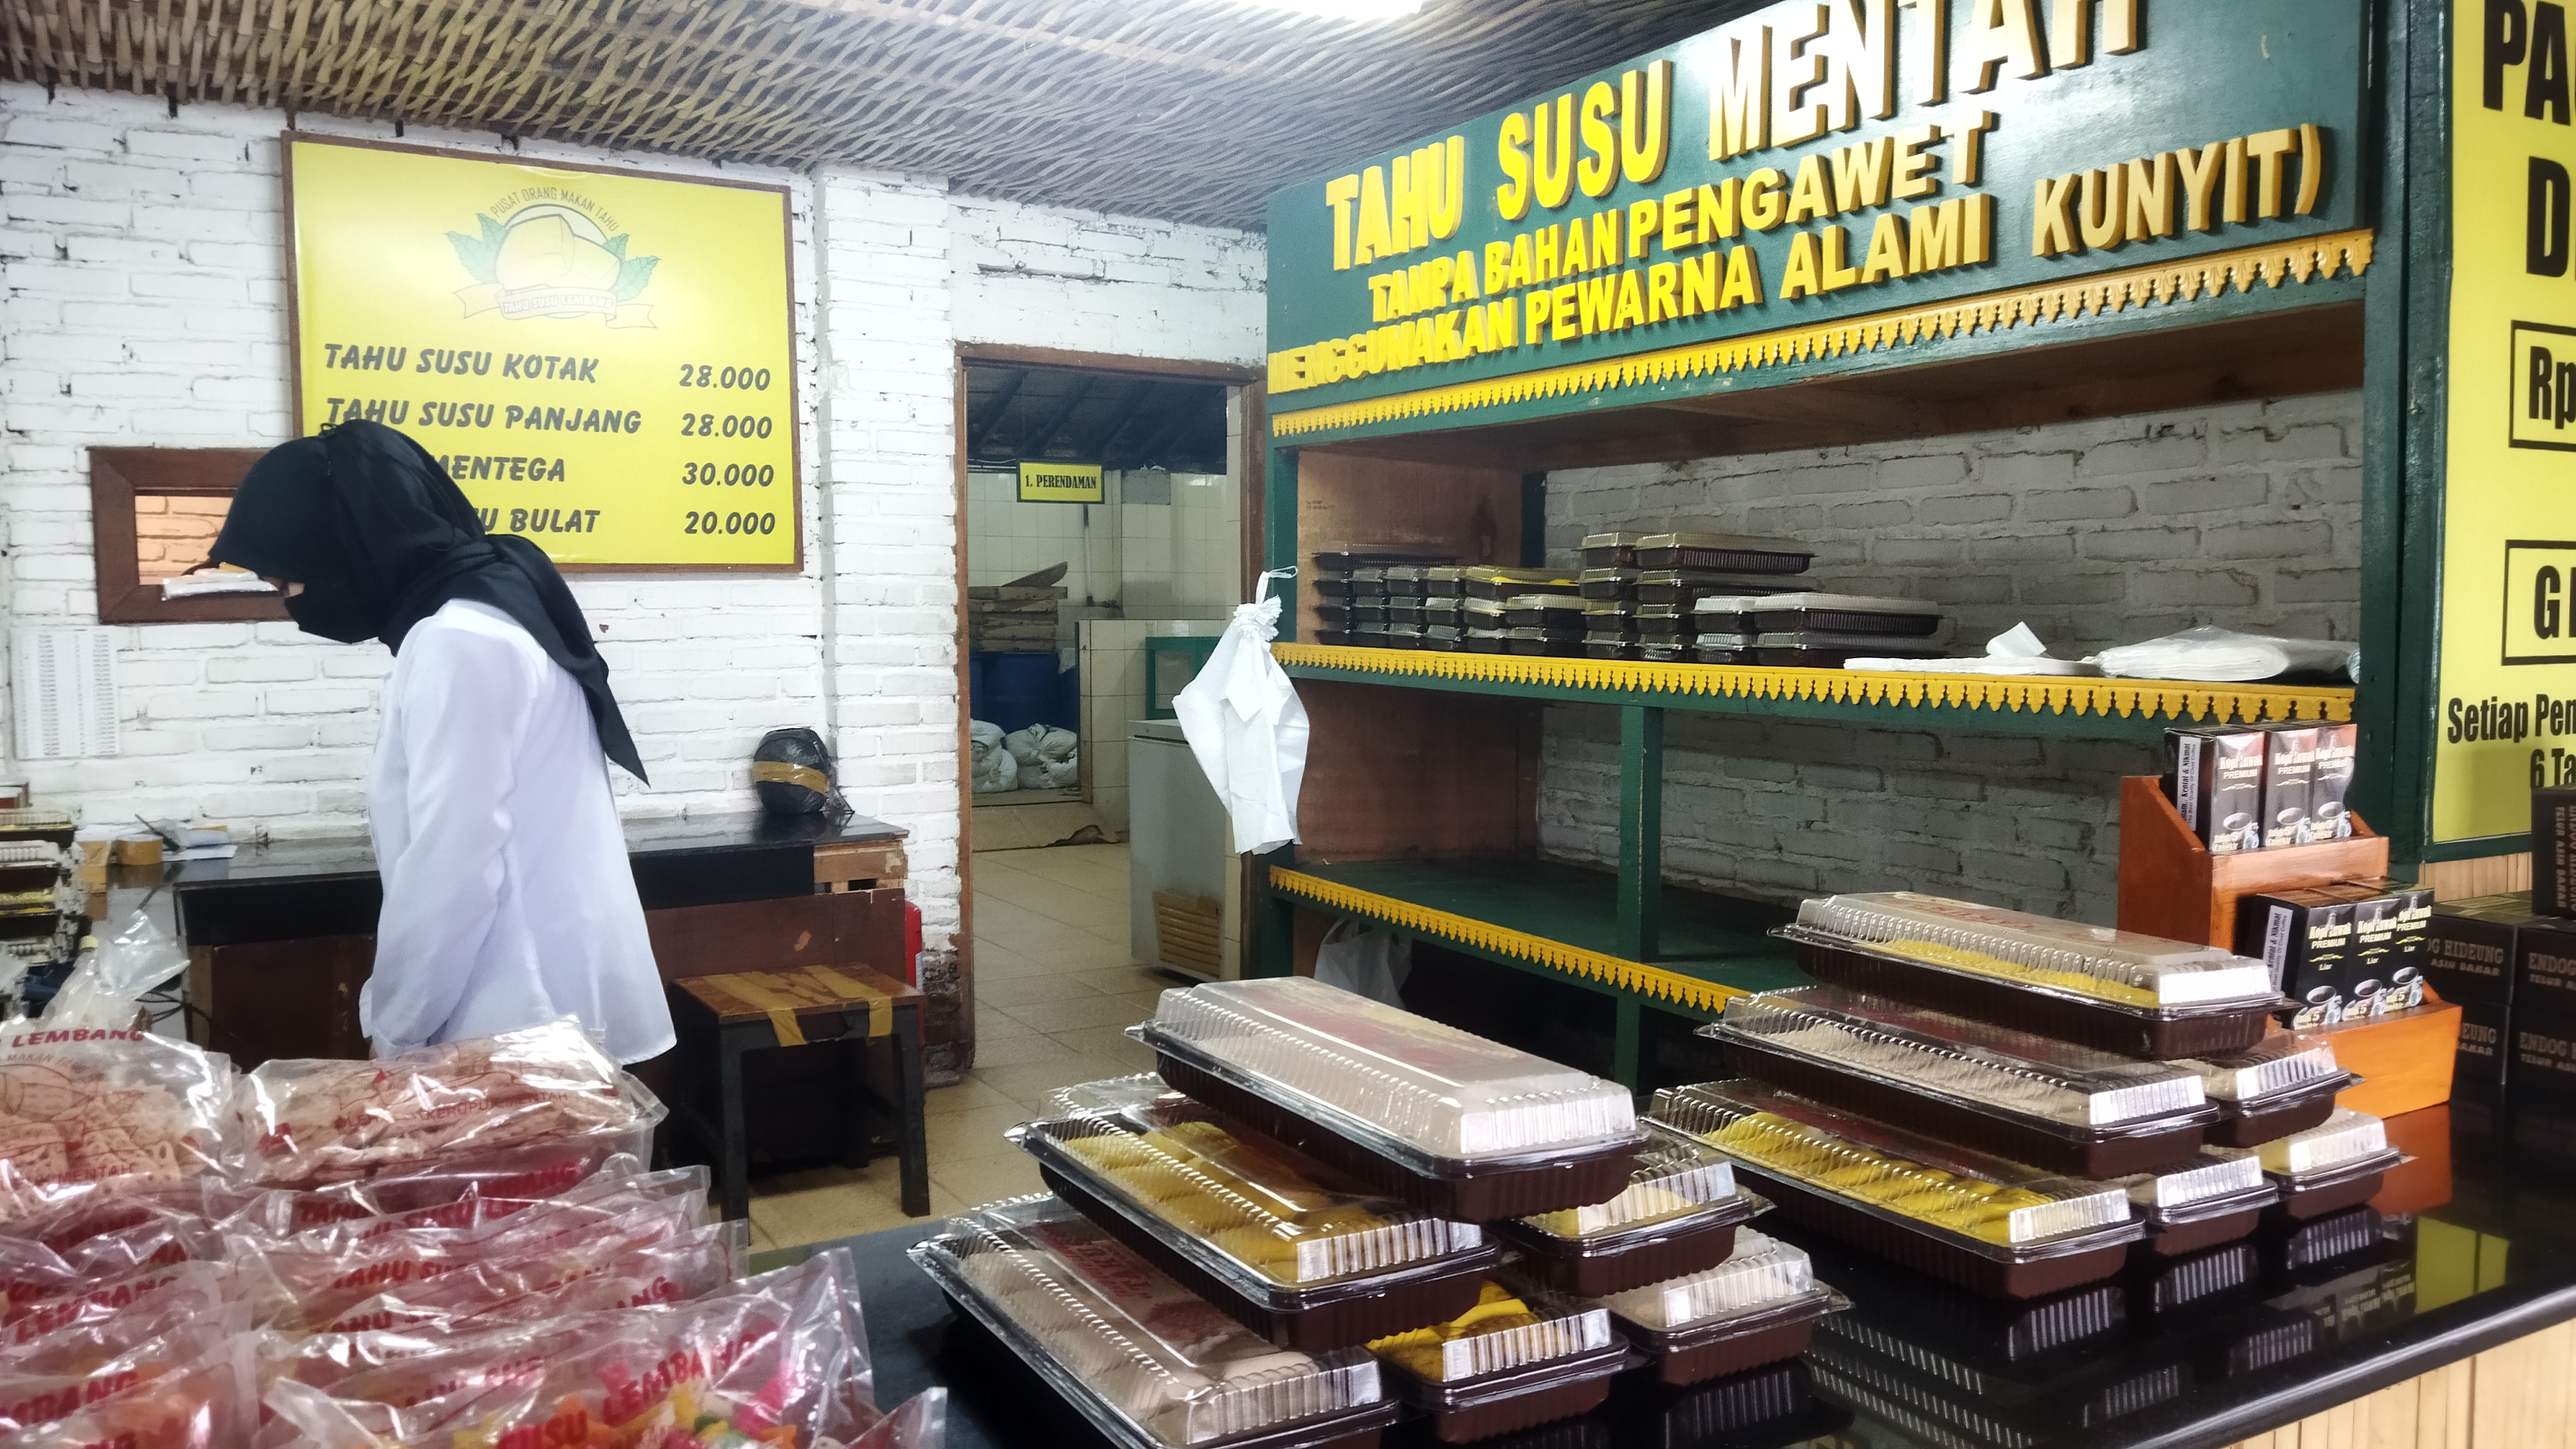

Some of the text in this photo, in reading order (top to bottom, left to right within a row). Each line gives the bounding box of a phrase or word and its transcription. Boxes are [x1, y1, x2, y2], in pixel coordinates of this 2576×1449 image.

[2483, 0, 2576, 127] PA
[1326, 134, 1466, 271] TAHU
[1495, 59, 1673, 222] SUSU
[489, 186, 620, 231] PUSAT ORANG MAKAN TAHU
[1368, 109, 1999, 323] TANPA BAHAN PENGAWET
[2526, 155, 2576, 281] D
[1267, 122, 2322, 394] MENGGUNAKAN PEWARNA ALAMI KUNYIT)
[502, 294, 614, 314] TAHU SUSU LEMBANG
[324, 343, 600, 384] TAHU SUSU KOTAK
[679, 363, 772, 392] 28.000
[326, 397, 642, 434] TAHU SUSU PANJANG
[680, 412, 773, 440] 28.000
[682, 462, 775, 488] 30.000
[1025, 473, 1097, 489] 1. PERENDAMAN
[509, 507, 601, 533] BULAT
[684, 511, 775, 536] 20.000
[2447, 696, 2529, 744] Setiap
[2183, 743, 2191, 766] Nikmat
[2318, 759, 2347, 770] PREMIUM
[2223, 769, 2258, 779] PREMIUM
[2277, 764, 2311, 775] PREMIUM
[2530, 748, 2546, 790] 6
[2181, 776, 2190, 797] Kental
[2271, 913, 2282, 937] Nikmat
[2396, 920, 2427, 932] PREMIUM
[2311, 938, 2346, 949] PREMIUM
[2360, 932, 2392, 943] PREMIUM
[2443, 939, 2504, 964] HIDEUNG
[2430, 958, 2500, 976] ASIN BAKAR
[2529, 973, 2562, 987] TELUR
[2312, 1011, 2320, 1021] 5
[2359, 1004, 2367, 1014] 5
[12, 1028, 144, 1048] LEMBANG
[2461, 1023, 2497, 1045] EUNG
[2519, 1031, 2567, 1057] ENDOG
[6, 1052, 55, 1063] MAKAN
[2458, 1042, 2494, 1057] AKAR
[2521, 1053, 2553, 1068] TELUR
